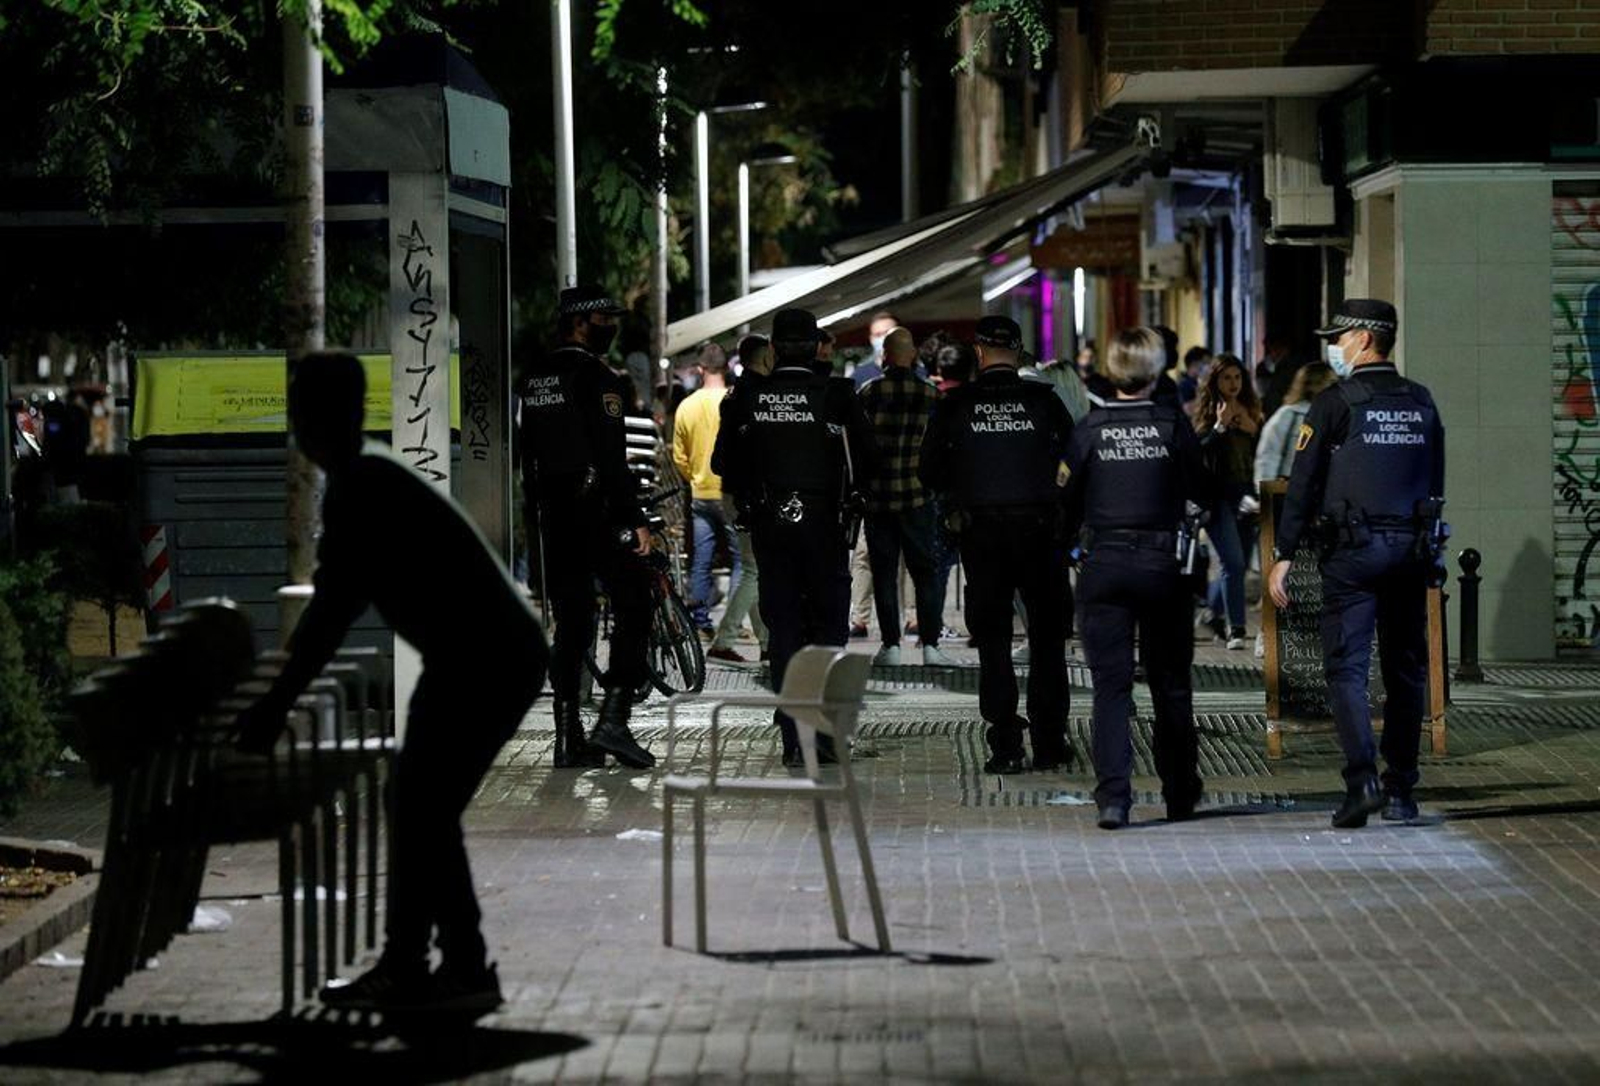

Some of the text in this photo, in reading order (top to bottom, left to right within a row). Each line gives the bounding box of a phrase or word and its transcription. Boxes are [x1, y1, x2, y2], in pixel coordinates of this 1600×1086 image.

[527, 376, 560, 388] POLICIA
[758, 393, 808, 404] POLICIA
[974, 402, 1025, 414] POLICIA
[753, 411, 815, 422] VALENCIA
[1366, 409, 1423, 422] POLICIA
[970, 420, 1035, 432] VALENCIA
[1379, 423, 1411, 432] LOCAL
[1101, 425, 1160, 440] POLICIA
[1115, 439, 1145, 449] LOCAL
[1097, 444, 1170, 461] VALENCIA
